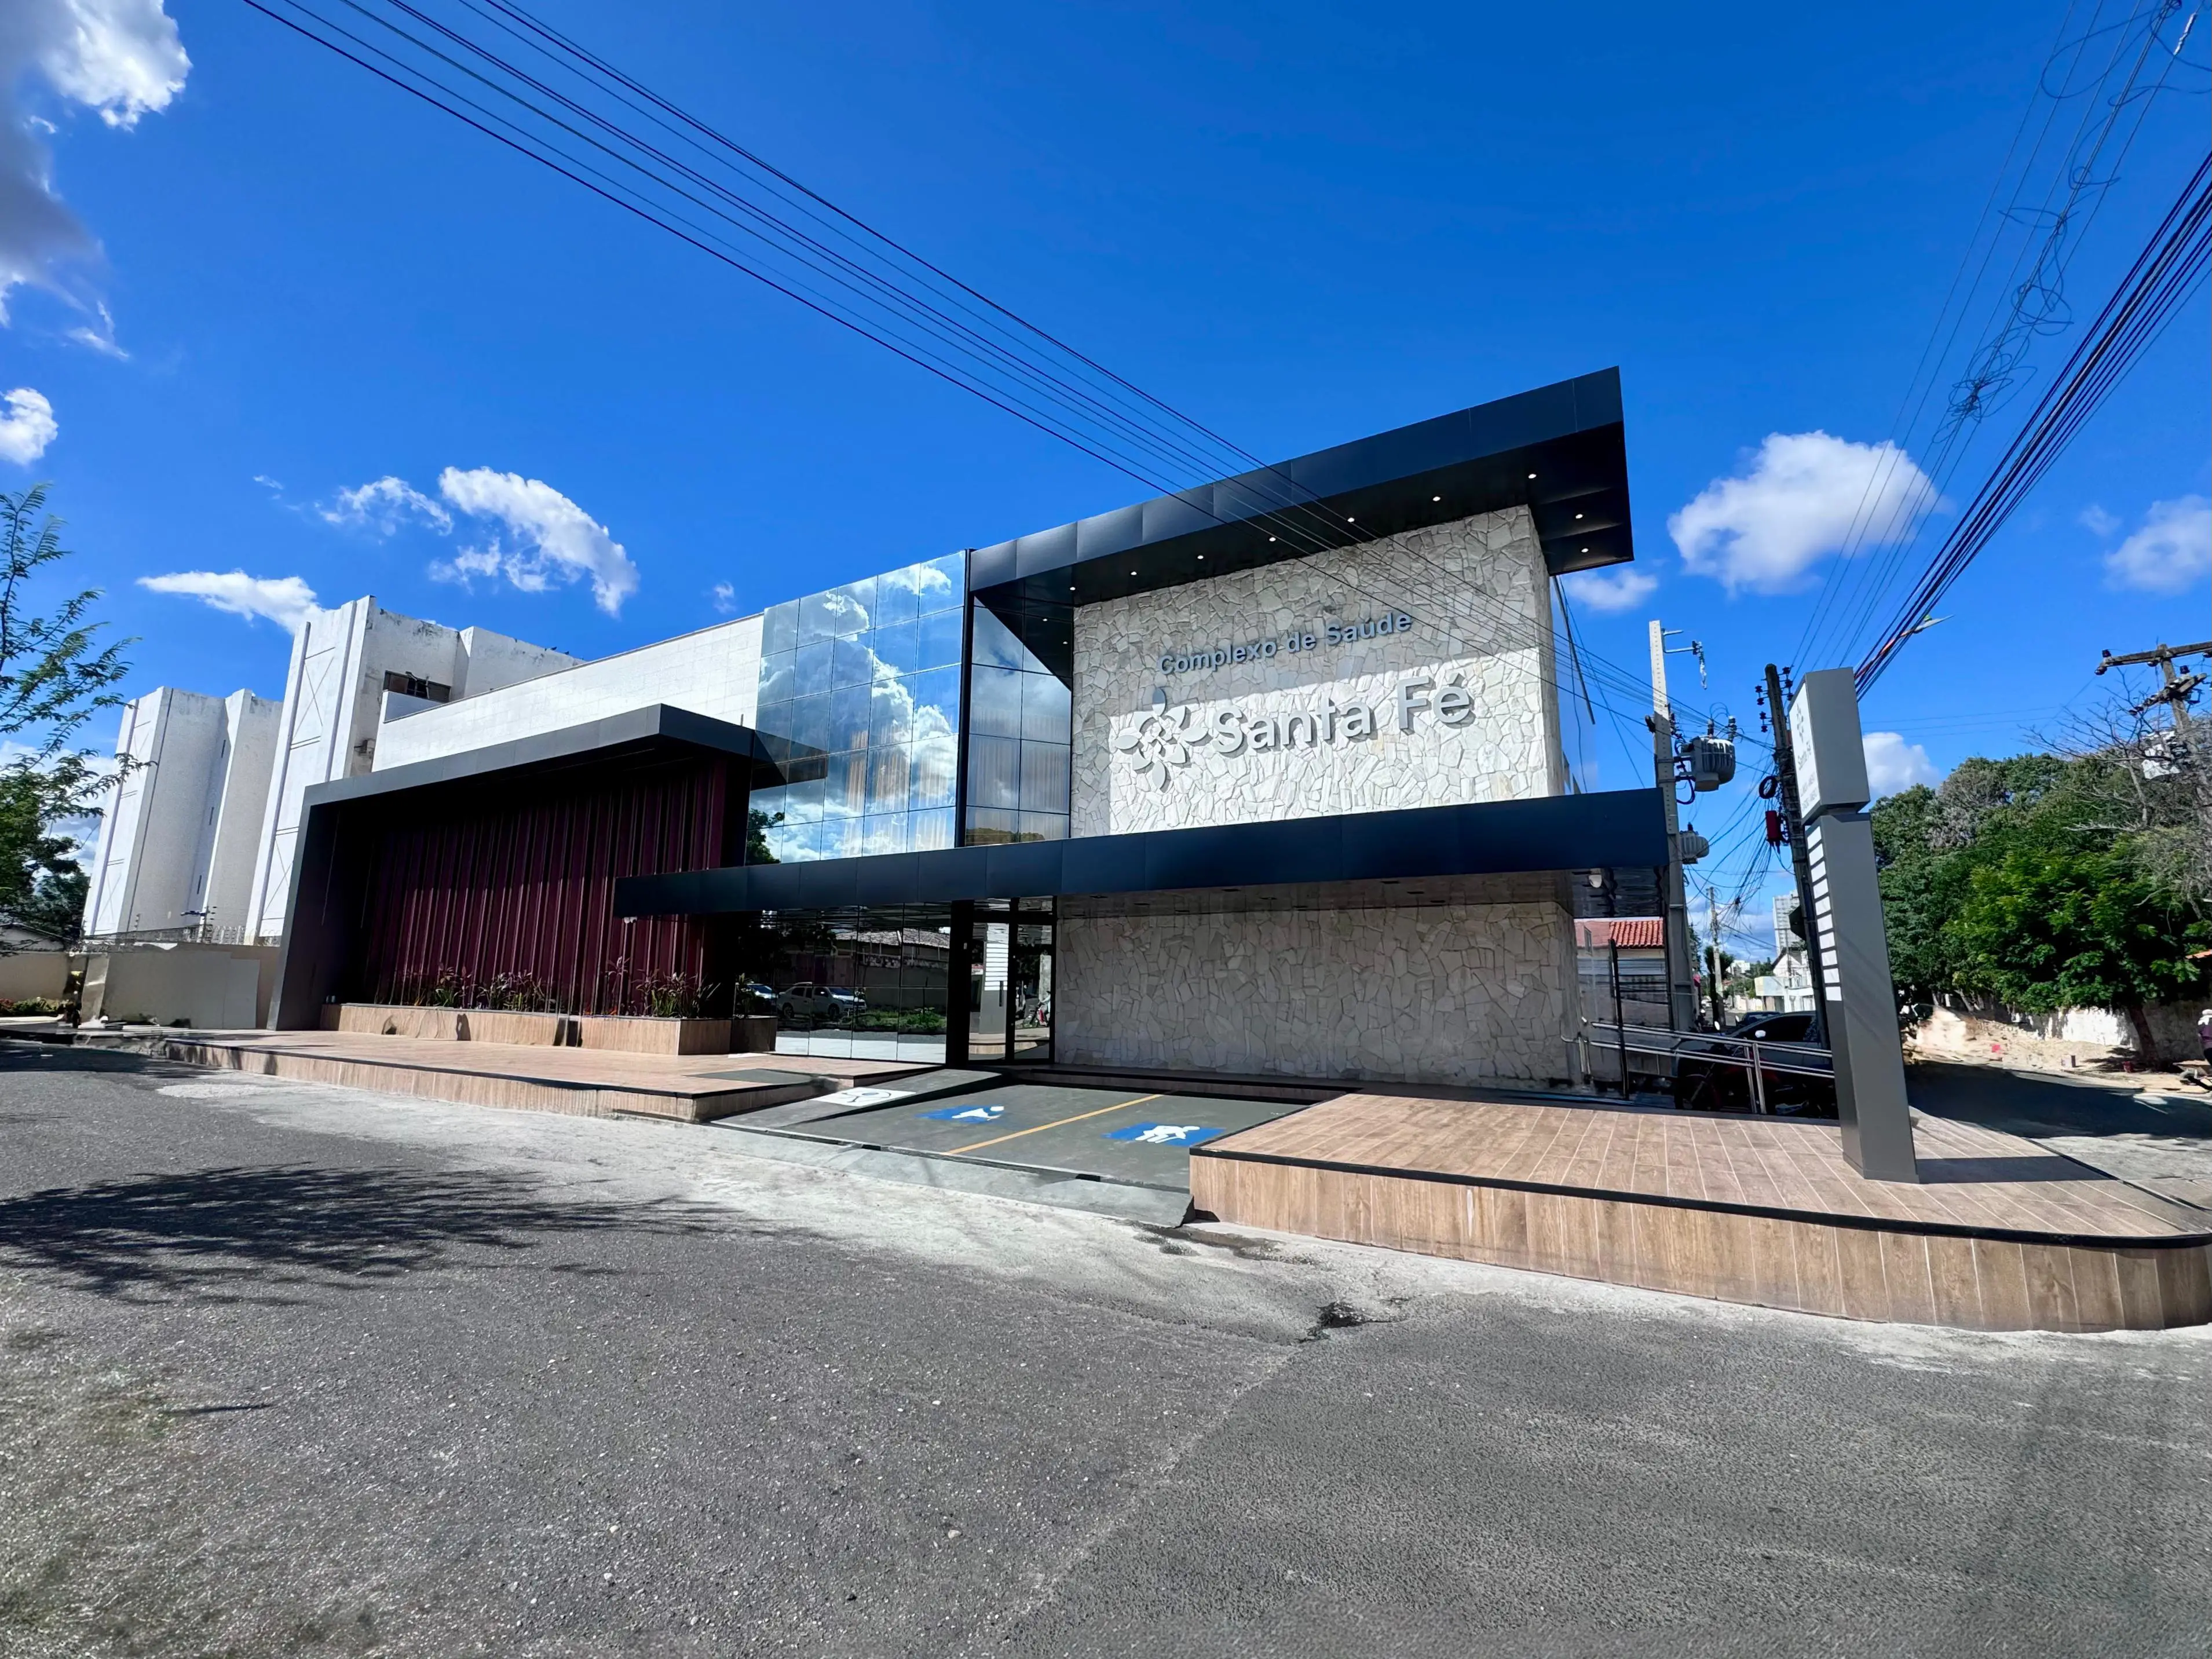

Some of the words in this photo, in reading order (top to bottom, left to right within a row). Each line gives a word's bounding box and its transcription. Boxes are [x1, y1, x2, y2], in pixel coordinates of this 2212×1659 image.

[1160, 641, 1277, 675] Complexo
[1286, 632, 1317, 653] de
[1327, 612, 1412, 645] Saúde
[1216, 698, 1372, 753] Santa
[1396, 673, 1472, 731] Fé
